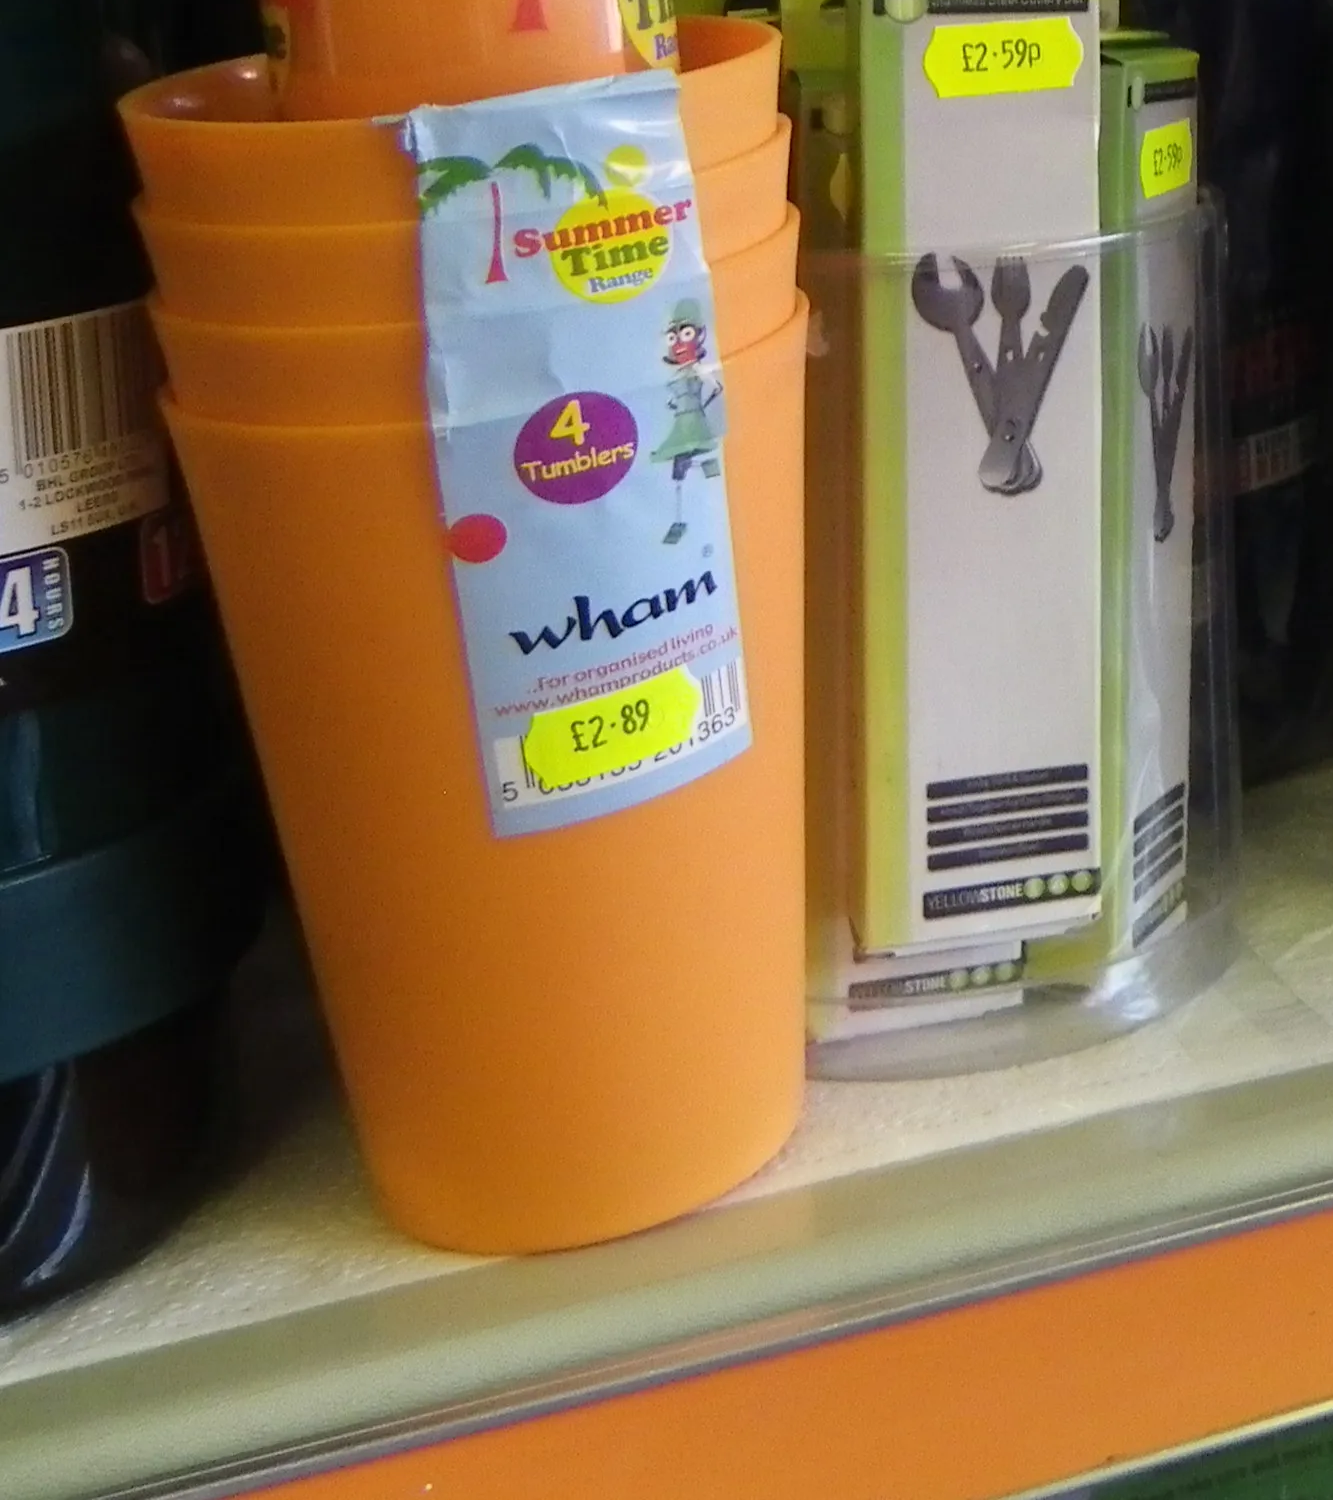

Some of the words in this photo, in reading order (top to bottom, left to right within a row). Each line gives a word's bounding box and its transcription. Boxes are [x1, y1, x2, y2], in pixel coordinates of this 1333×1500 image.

[512, 198, 693, 259] Summer
[561, 235, 669, 278] Time
[587, 265, 654, 294] Range
[549, 399, 590, 446] 4
[520, 440, 635, 482] Tumblers
[41, 555, 65, 633] HOURS
[508, 569, 718, 656] wham
[572, 640, 670, 685] organised
[670, 623, 715, 650] living
[928, 881, 1025, 911] YELLOWSTONE
